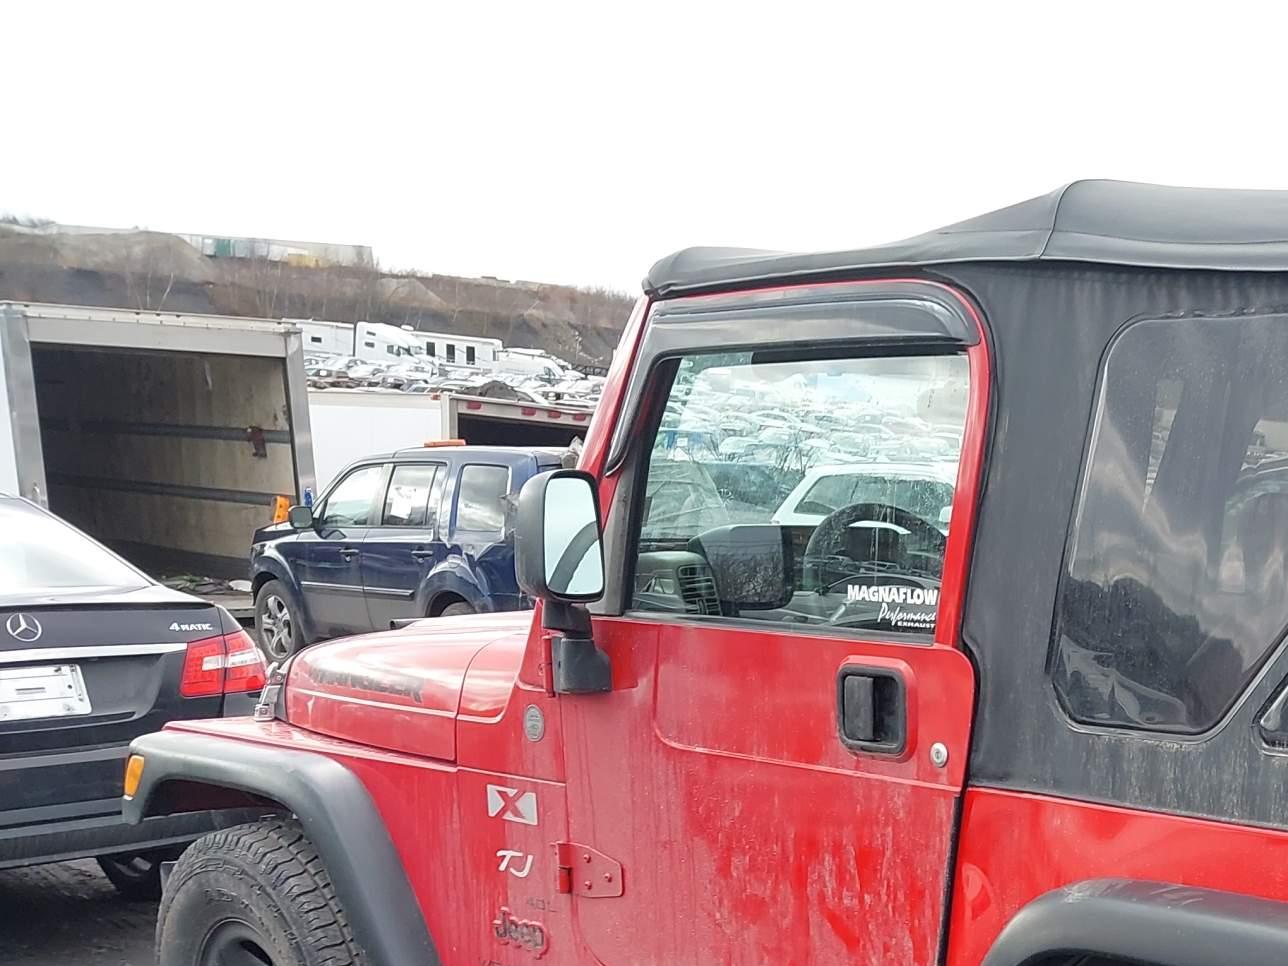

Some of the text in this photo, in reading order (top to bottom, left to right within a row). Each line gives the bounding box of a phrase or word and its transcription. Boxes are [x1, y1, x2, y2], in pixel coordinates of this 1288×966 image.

[847, 584, 938, 606] MAGNAFLOW
[897, 620, 937, 629] EXHAUST
[496, 849, 534, 878] TJ
